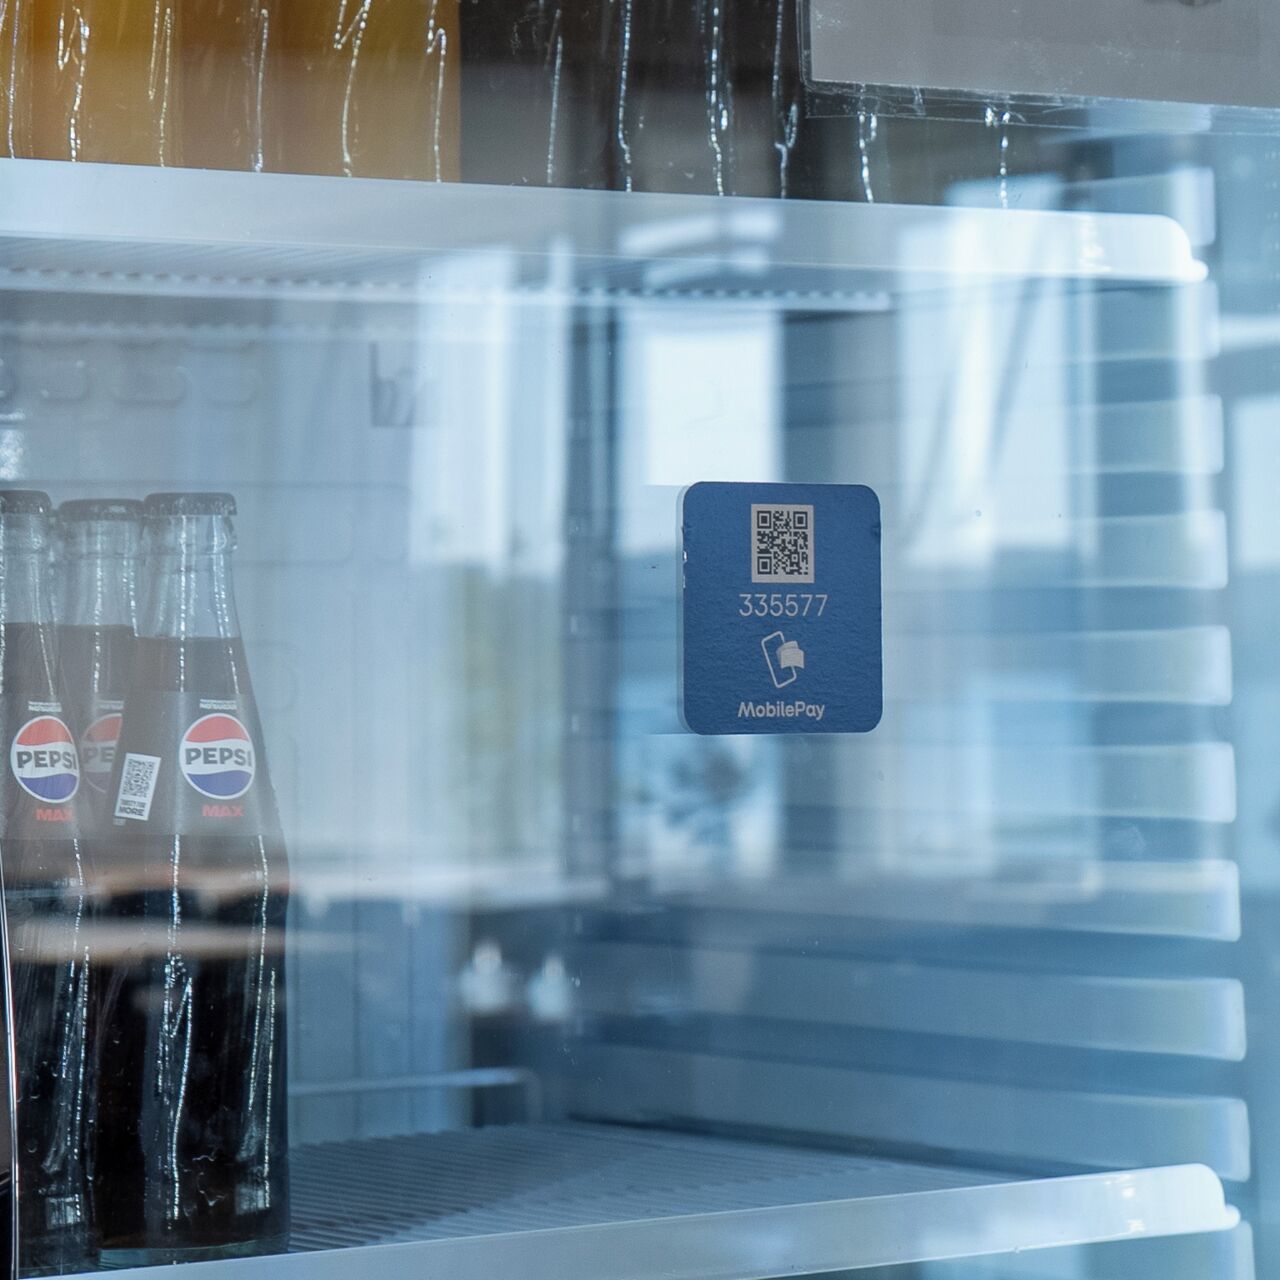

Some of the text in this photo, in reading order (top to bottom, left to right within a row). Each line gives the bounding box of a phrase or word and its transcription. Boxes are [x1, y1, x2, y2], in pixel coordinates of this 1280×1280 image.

[739, 593, 828, 617] 335577
[738, 700, 825, 721] MobilePay
[16, 750, 77, 770] PEPSI
[185, 747, 253, 767] PEPSI
[36, 808, 73, 821] MAX
[202, 804, 244, 817] MAX
